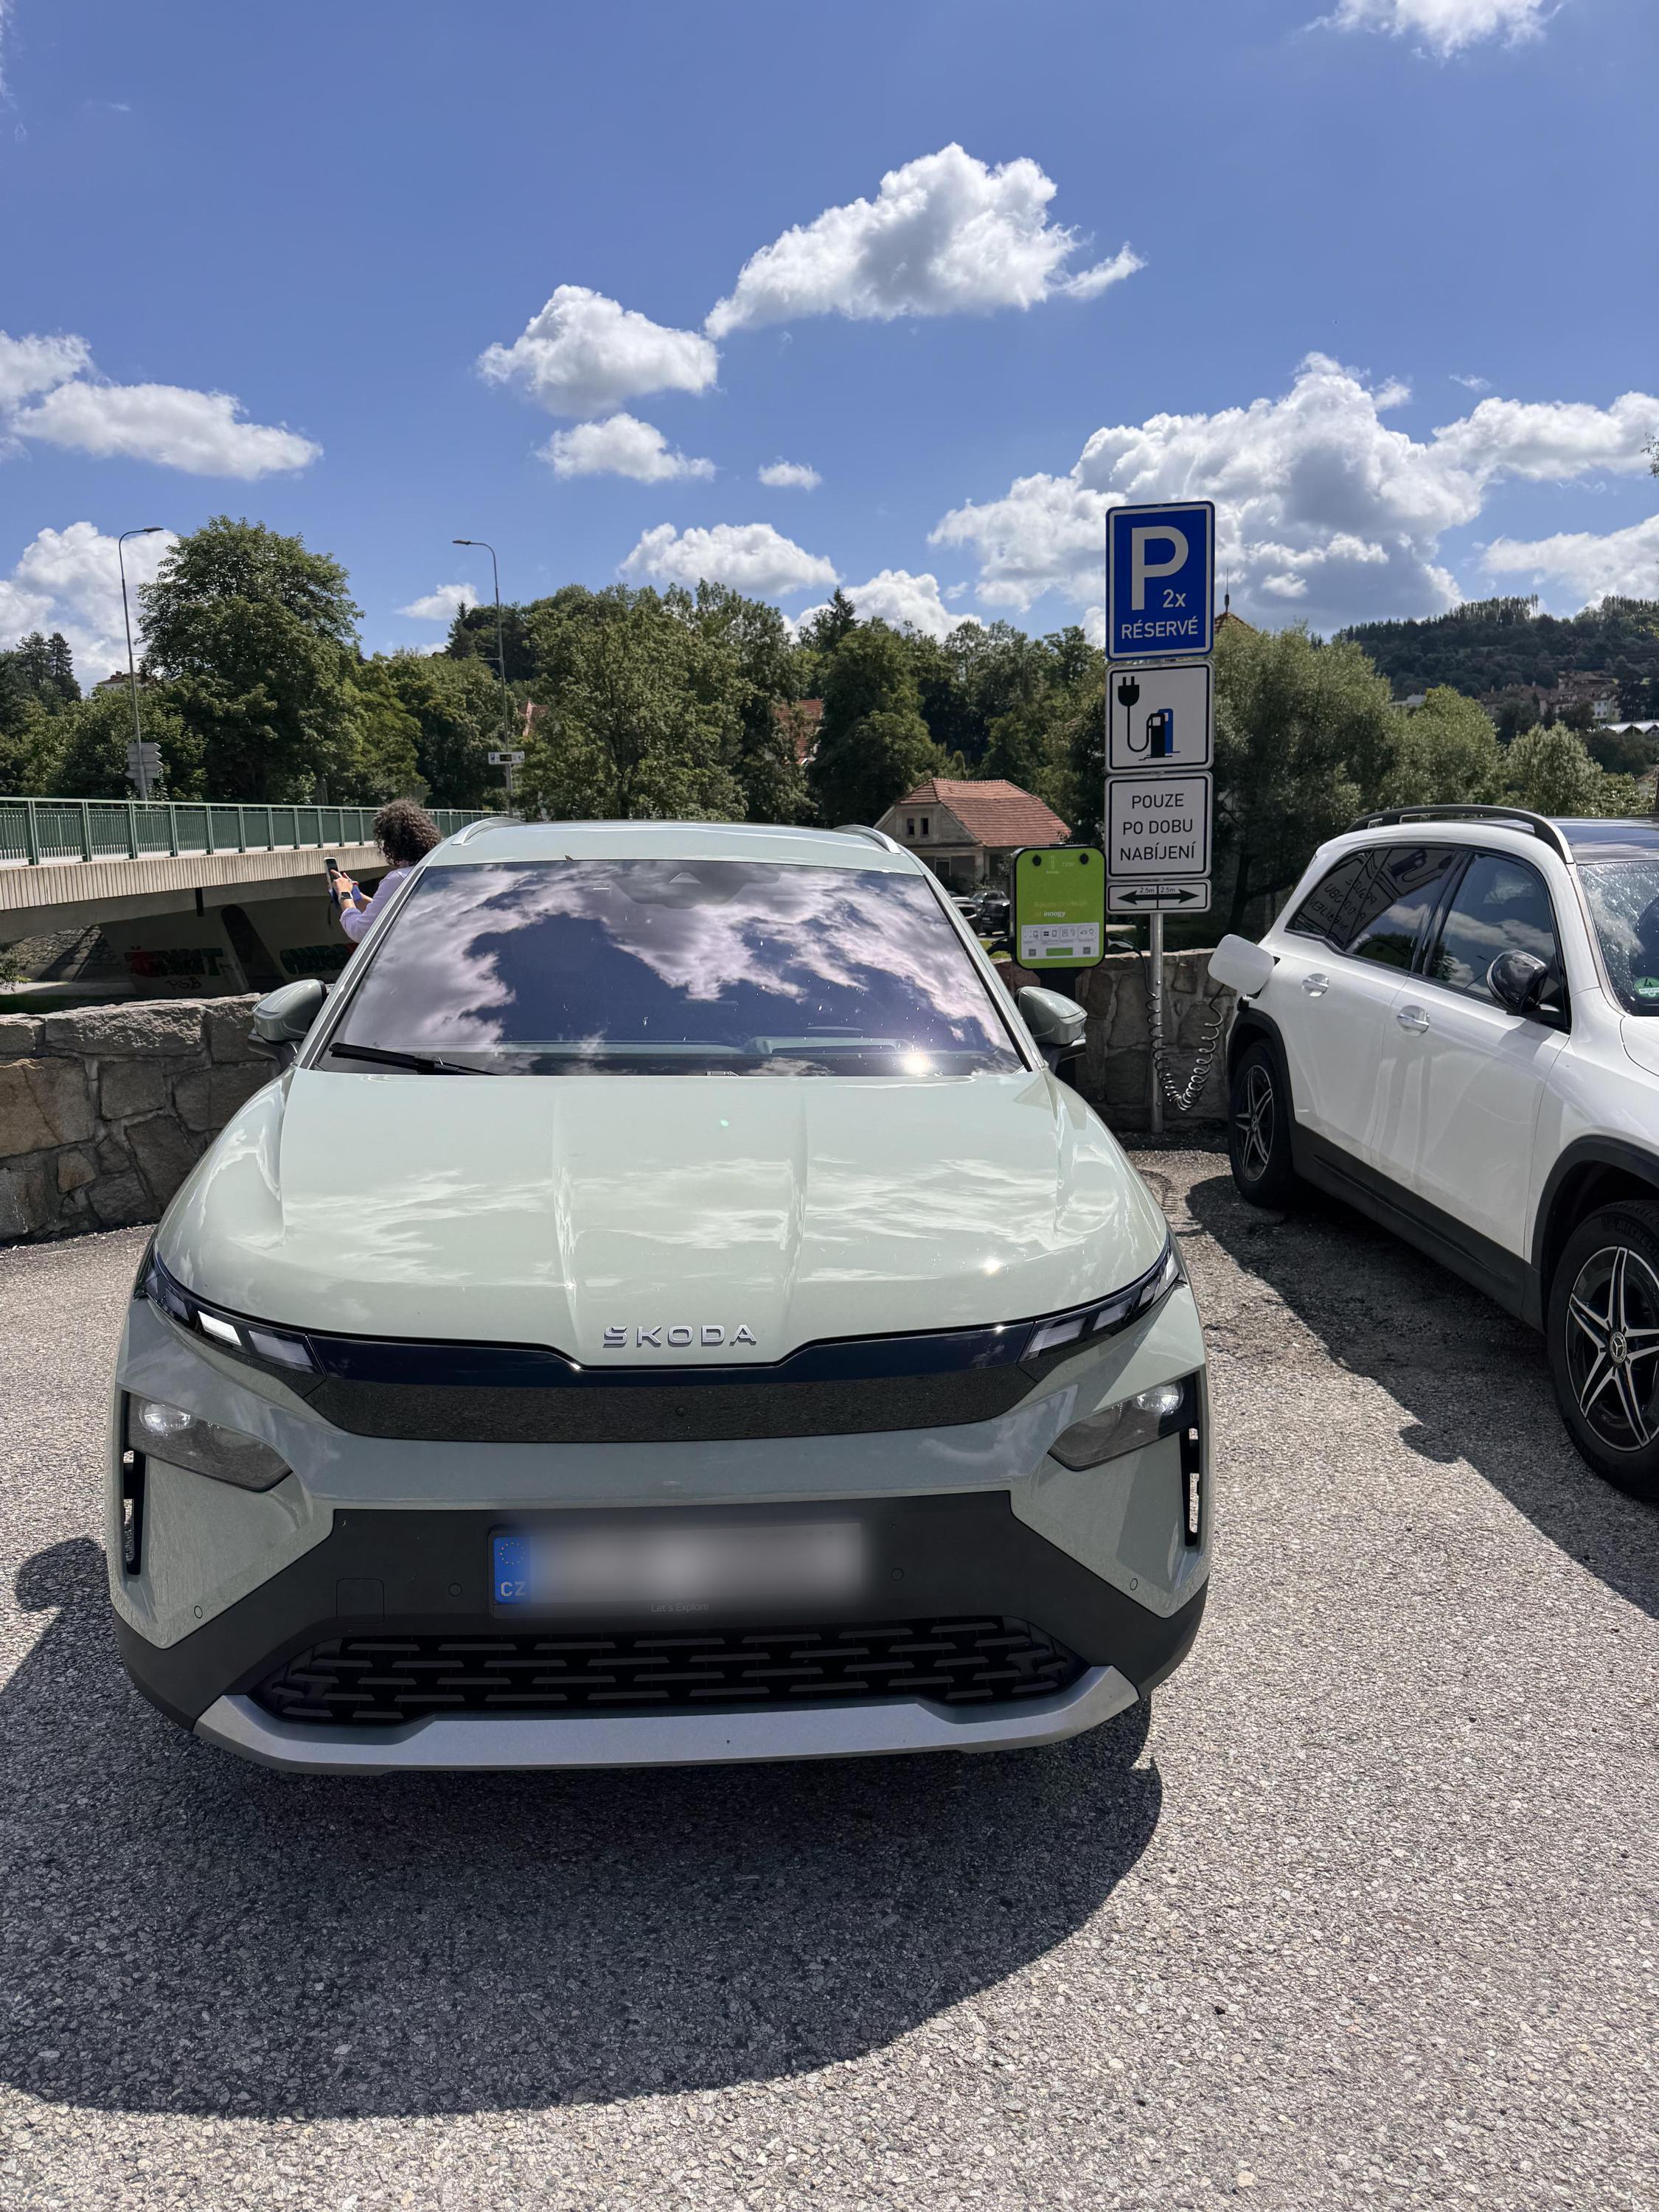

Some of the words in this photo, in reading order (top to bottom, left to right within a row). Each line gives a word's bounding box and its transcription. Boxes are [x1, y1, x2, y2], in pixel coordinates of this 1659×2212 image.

[1131, 525, 1189, 611] P
[1163, 589, 1186, 608] 2x
[1121, 616, 1198, 640] RÉSERVÉ
[1131, 793, 1184, 809] POUZE
[1122, 821, 1143, 835] PO
[1149, 818, 1193, 835] DOBU
[1120, 841, 1197, 861] NABÍJENÍ
[1043, 910, 1065, 918] innogy
[501, 1581, 526, 1597] CZ
[675, 1601, 709, 1613] Explore
